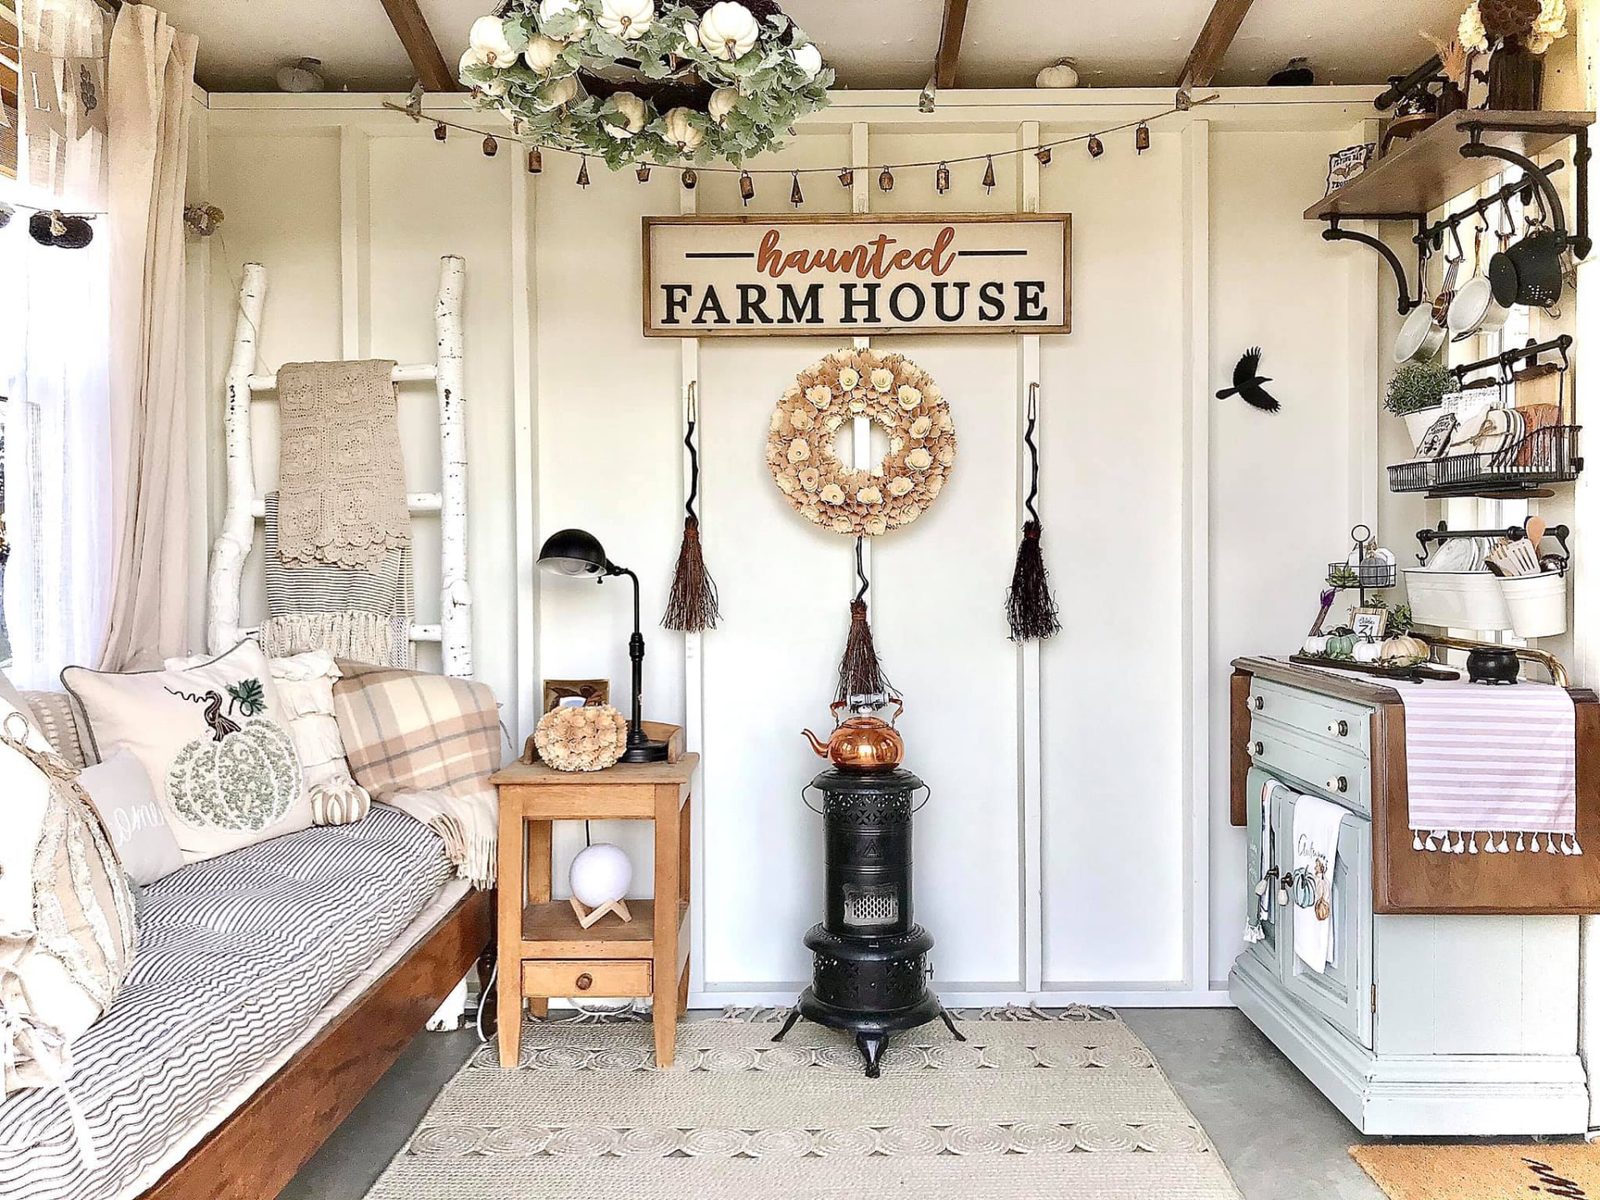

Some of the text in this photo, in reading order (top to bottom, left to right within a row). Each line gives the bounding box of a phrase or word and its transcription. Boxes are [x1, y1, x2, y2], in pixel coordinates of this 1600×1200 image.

[31, 71, 52, 112] L
[757, 226, 956, 280] haunted
[1358, 624, 1374, 641] 31
